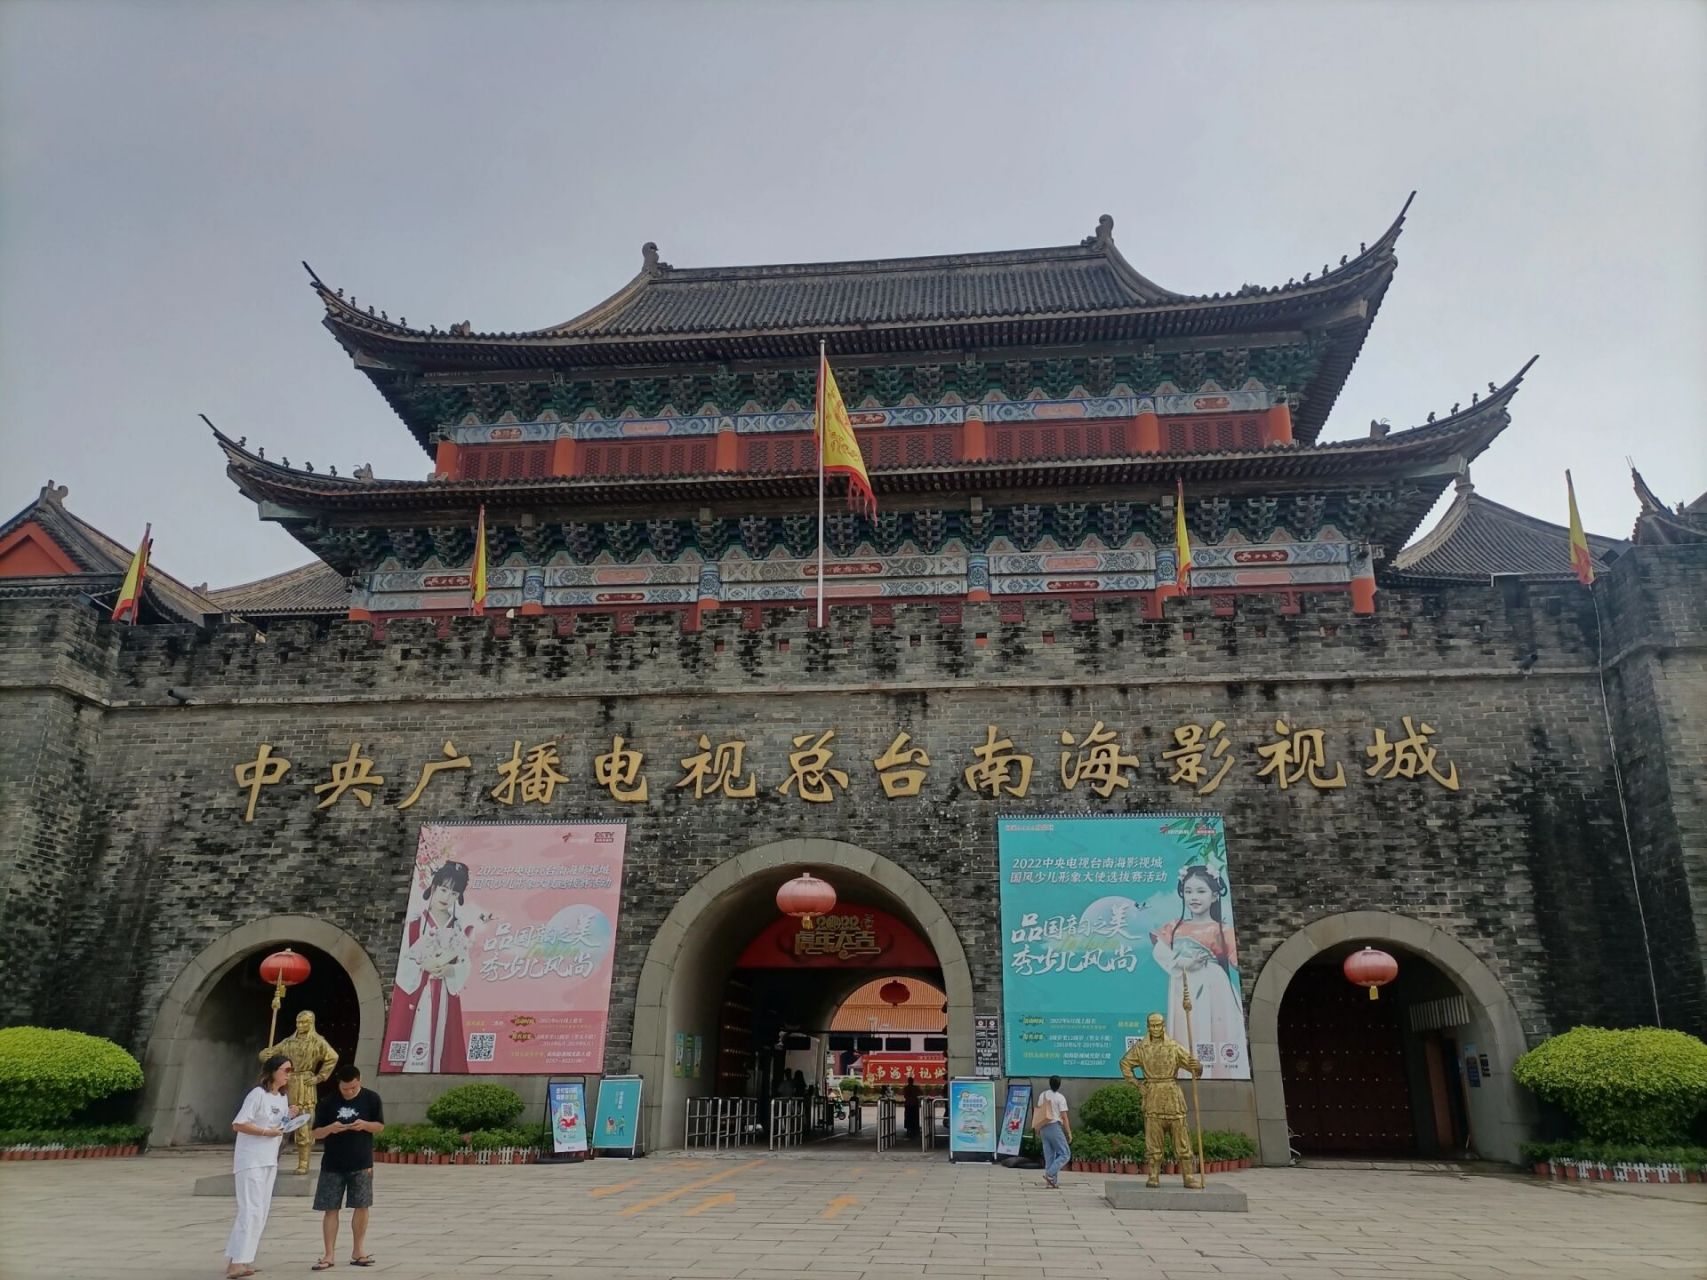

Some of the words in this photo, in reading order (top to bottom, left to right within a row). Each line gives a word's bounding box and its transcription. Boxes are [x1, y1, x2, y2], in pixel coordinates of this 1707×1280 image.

[234, 715, 1459, 822] 中央广播电视总台南海影视城
[795, 931, 881, 957] 虎年大吉
